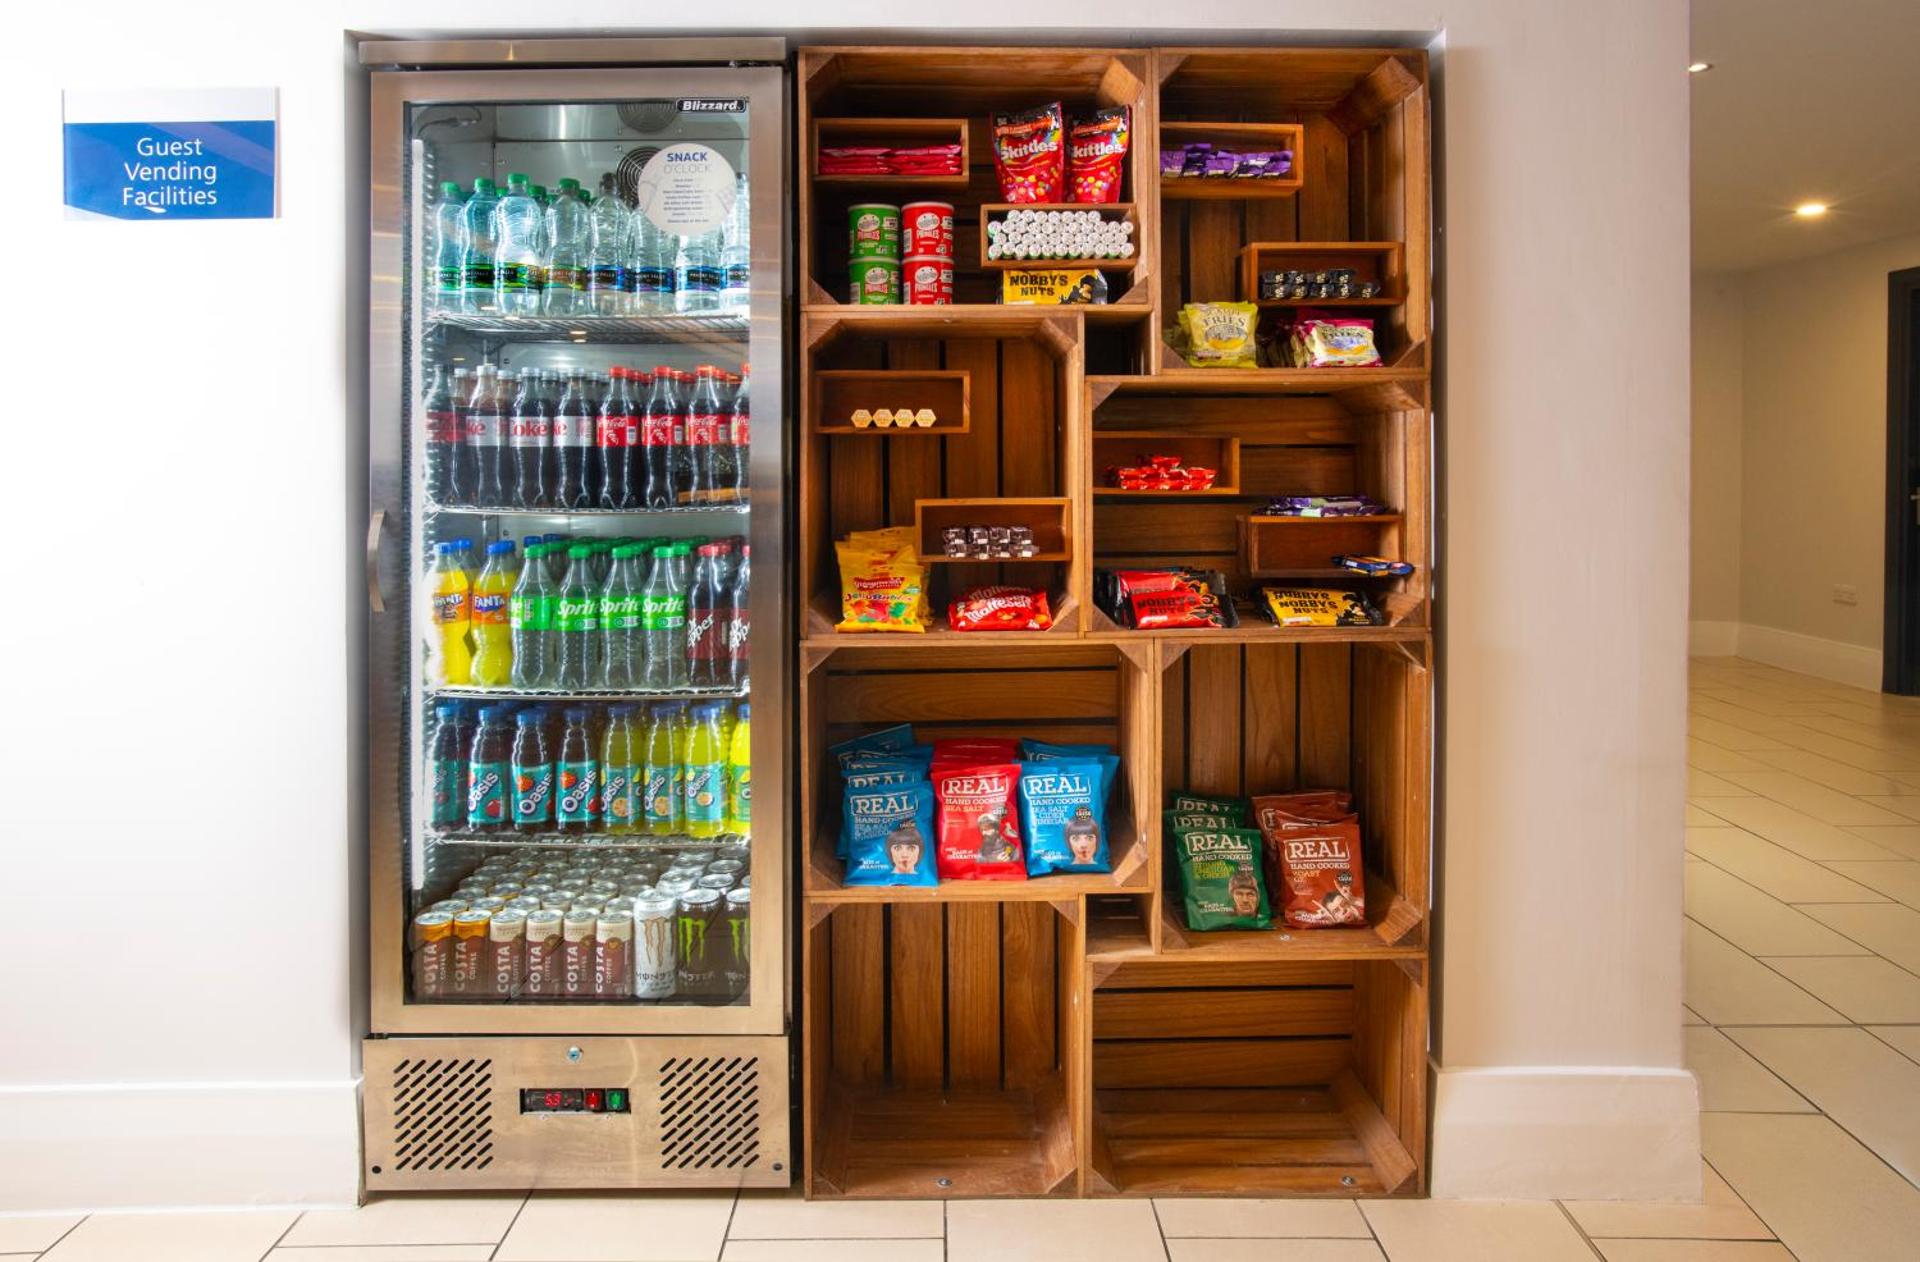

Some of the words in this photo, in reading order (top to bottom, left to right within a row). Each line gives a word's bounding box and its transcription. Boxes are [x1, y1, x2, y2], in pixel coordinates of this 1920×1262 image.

[682, 100, 738, 111] Blizzard
[137, 137, 203, 156] Guest
[667, 152, 708, 162] SNACK
[124, 161, 217, 184] Vending
[122, 187, 217, 206] Facilities
[1021, 287, 1055, 296] NUTS
[946, 777, 1004, 794] REAL
[1028, 776, 1086, 794] REAL
[855, 795, 915, 814] REAL
[1191, 833, 1248, 852] REAL
[1288, 841, 1346, 859] REAL
[424, 943, 437, 995] COSTA
[455, 941, 467, 992] COSTA
[497, 945, 511, 993] COSTA
[530, 945, 543, 993] COSTA
[567, 946, 578, 992] COSTA
[595, 946, 605, 994] COSTA
